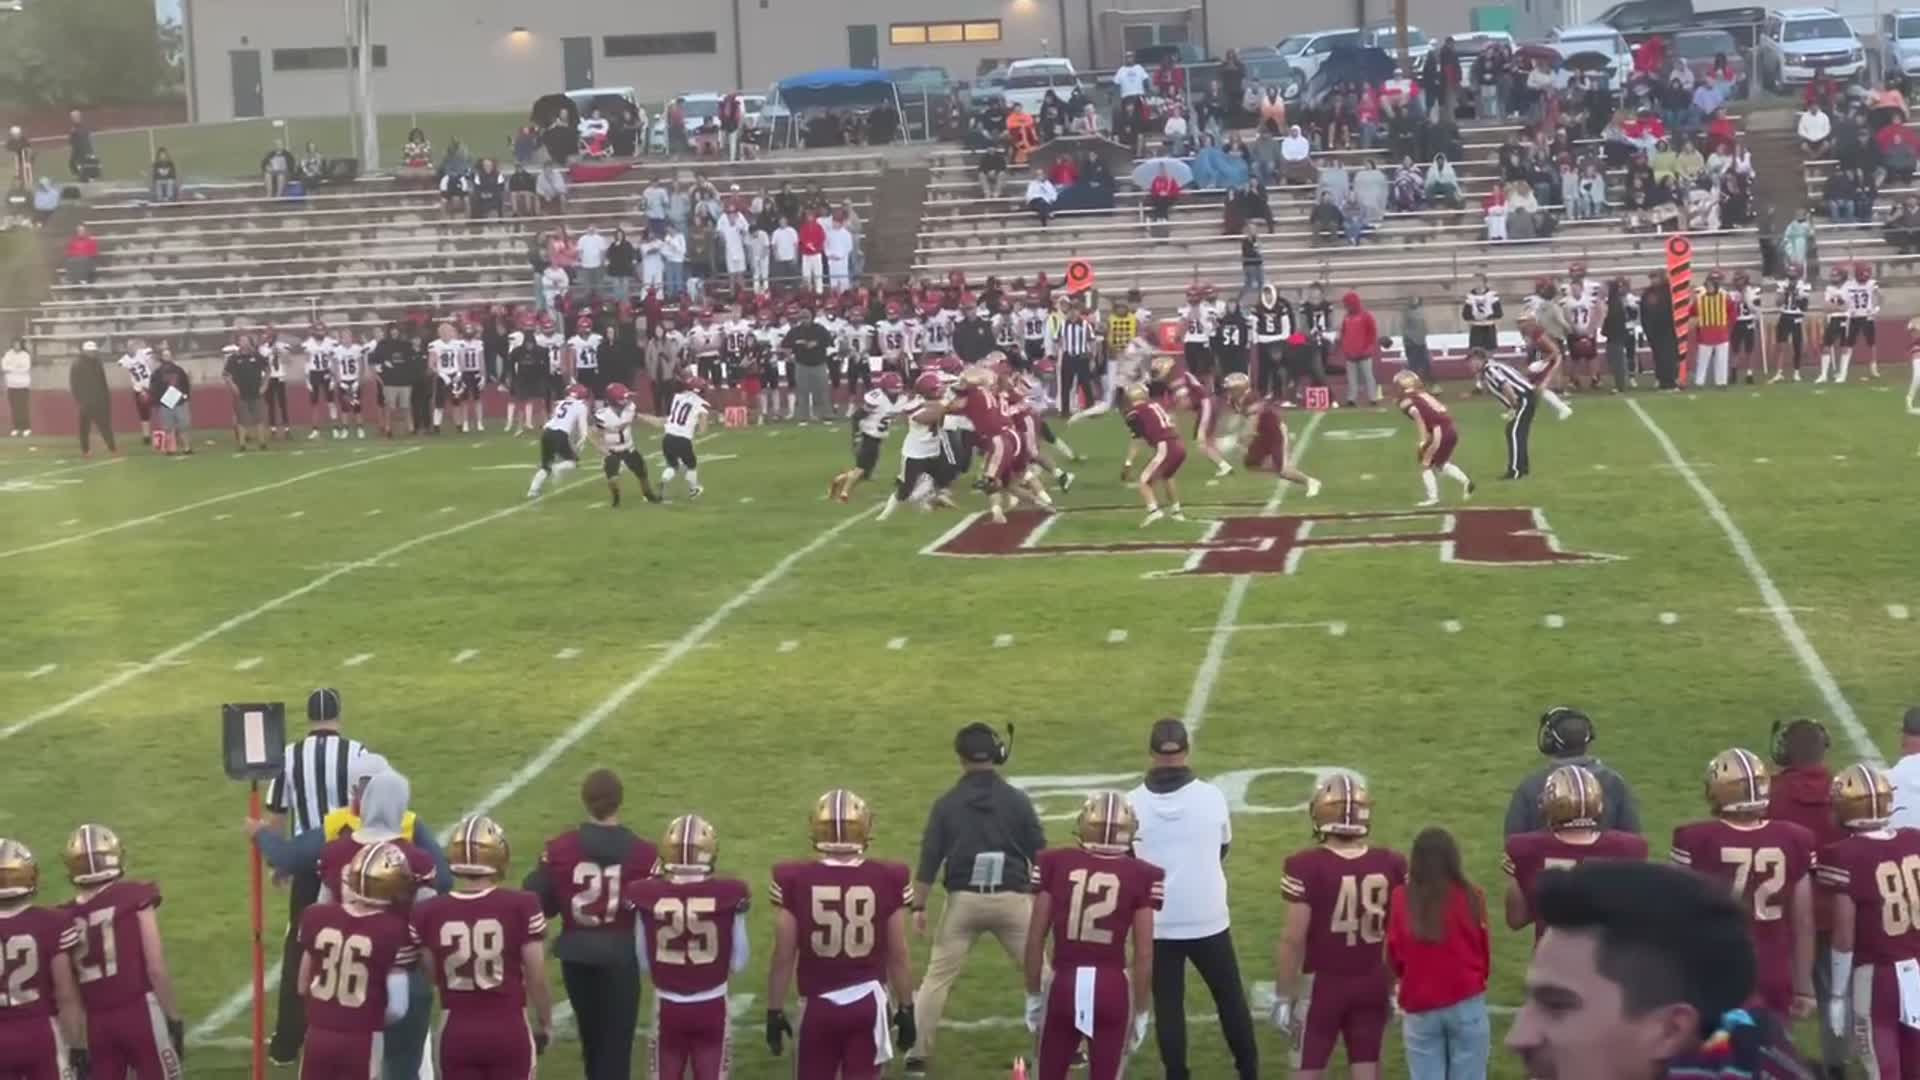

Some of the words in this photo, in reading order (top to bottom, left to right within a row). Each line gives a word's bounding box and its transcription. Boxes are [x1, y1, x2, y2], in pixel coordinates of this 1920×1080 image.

[1223, 325, 1240, 345] 54
[557, 401, 573, 420] 5
[670, 399, 693, 426] 10
[1308, 388, 1327, 407] 50
[572, 861, 622, 927] 21
[1066, 868, 1121, 944] 12
[1331, 873, 1390, 947] 48
[1720, 846, 1786, 921] 72
[72, 906, 118, 984] 27
[440, 918, 504, 990] 28
[653, 896, 719, 965] 25
[811, 885, 876, 958] 58
[0, 933, 40, 1007] 2
[309, 926, 373, 1008] 36
